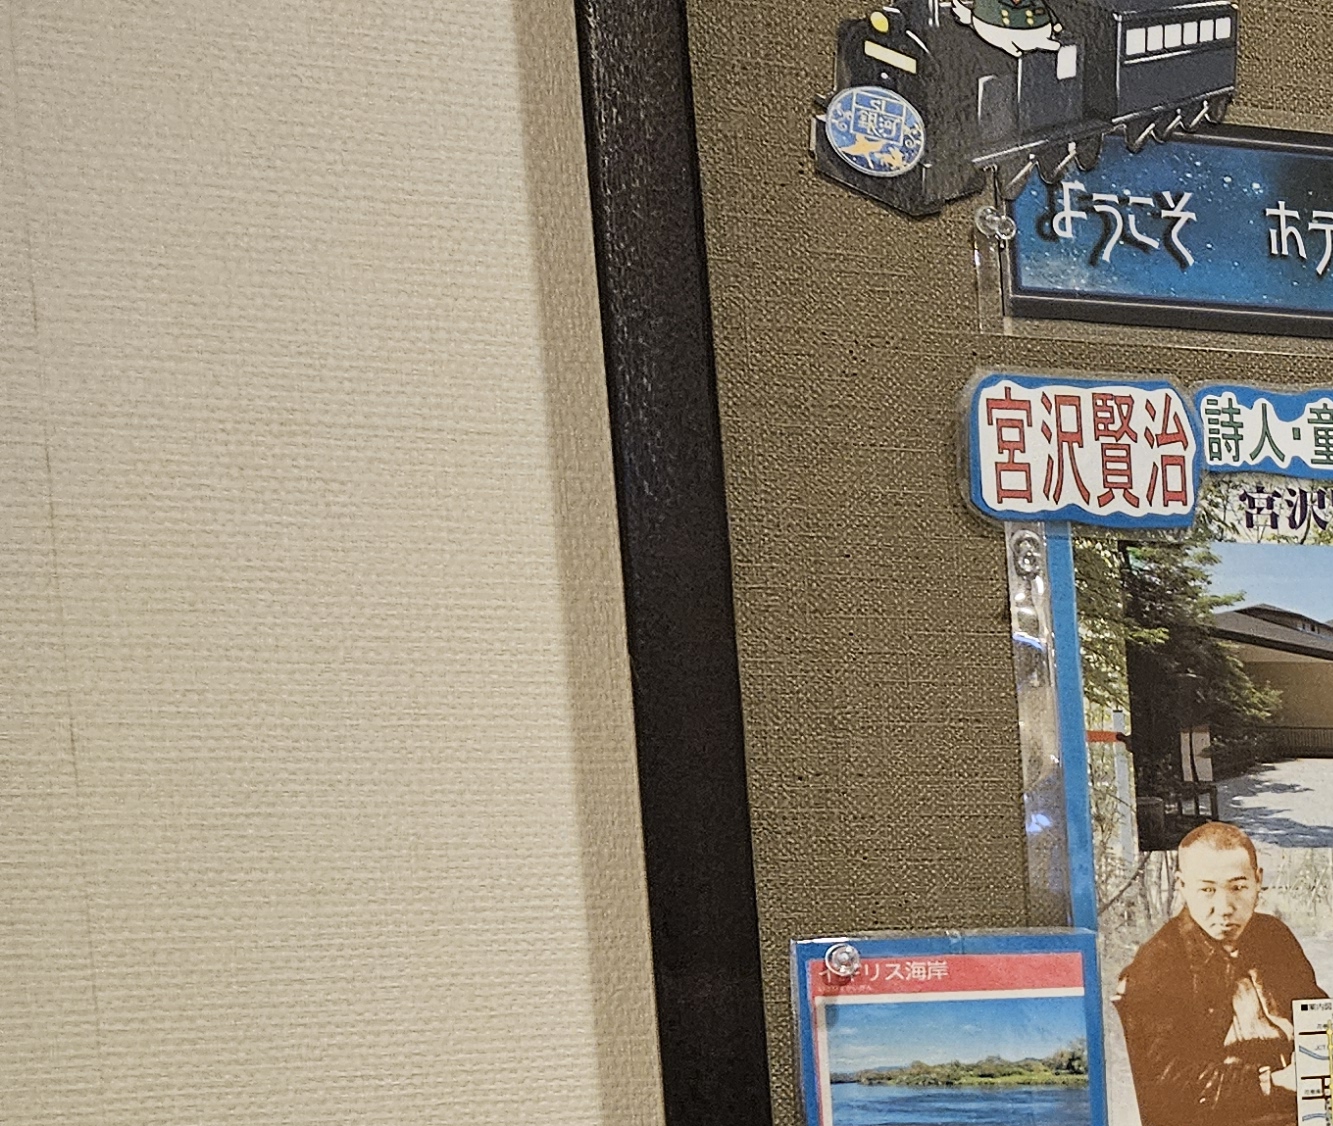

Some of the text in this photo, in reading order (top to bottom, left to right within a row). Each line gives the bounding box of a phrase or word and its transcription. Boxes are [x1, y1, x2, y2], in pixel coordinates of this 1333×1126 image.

[1051, 179, 1198, 268] ようこそ
[986, 386, 1189, 508] 宮沢賢治
